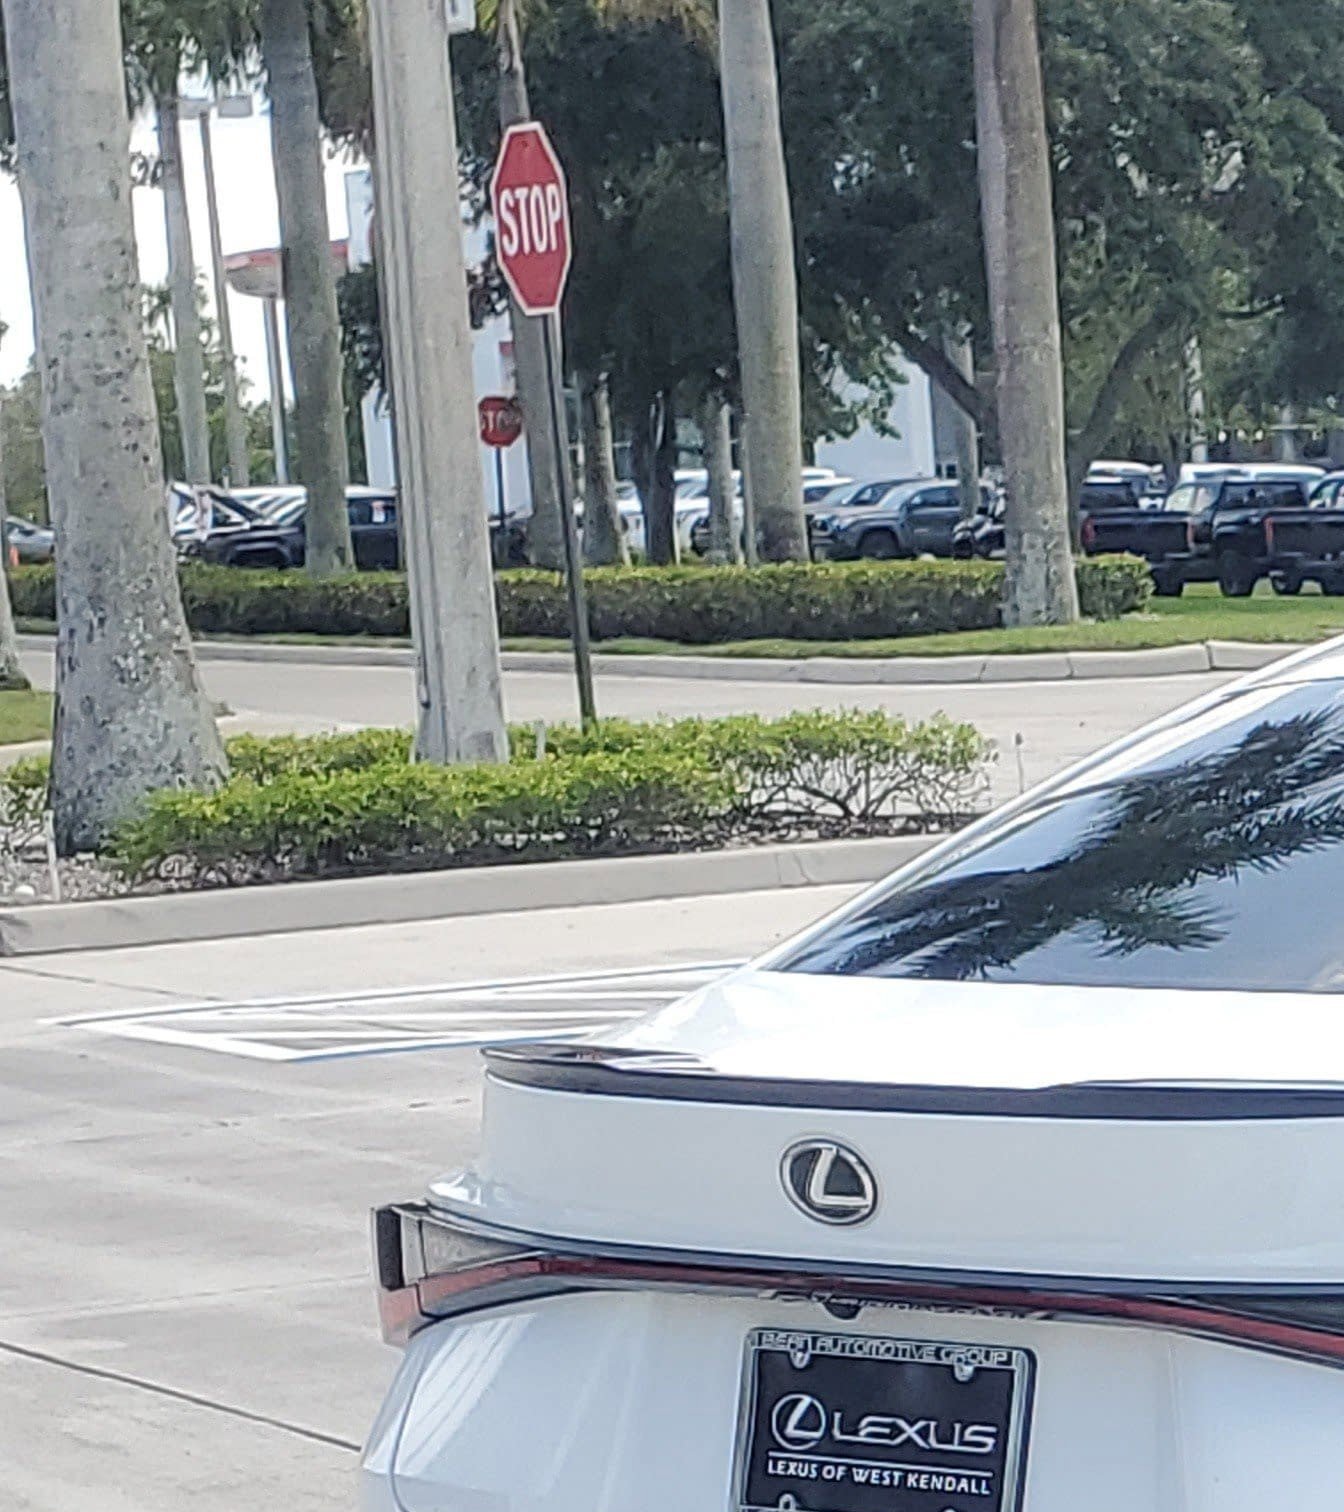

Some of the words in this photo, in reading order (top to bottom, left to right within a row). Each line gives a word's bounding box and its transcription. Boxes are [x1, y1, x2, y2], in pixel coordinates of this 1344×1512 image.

[501, 184, 562, 257] STOP
[815, 1337, 936, 1361] AUTOMOTIVE
[832, 1411, 998, 1454] LEXUS
[767, 1459, 818, 1479] LEXUS
[822, 1465, 846, 1482] OF
[852, 1467, 901, 1487] WEST
[906, 1472, 991, 1496] KENDALL
